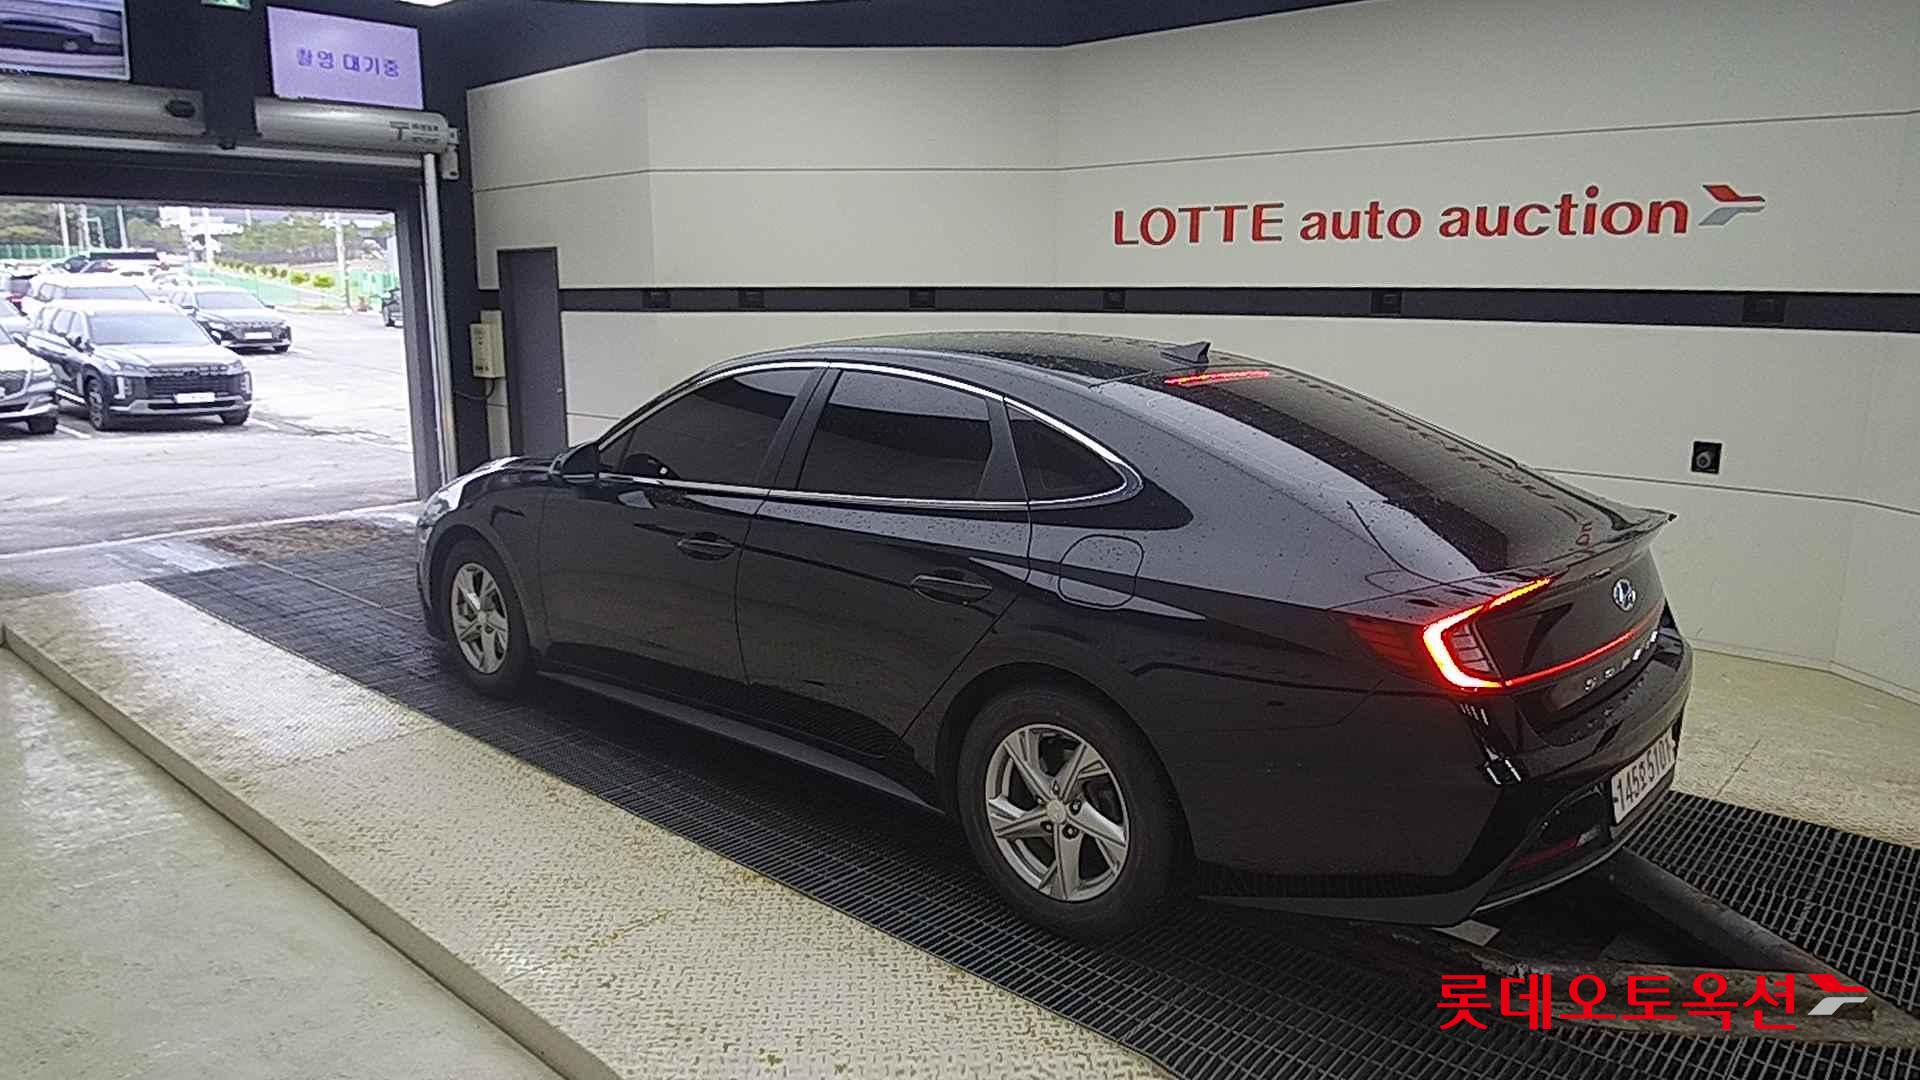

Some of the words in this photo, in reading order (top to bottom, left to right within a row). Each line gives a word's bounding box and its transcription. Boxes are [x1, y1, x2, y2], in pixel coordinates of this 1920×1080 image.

[297, 48, 334, 70] 촬영
[343, 53, 399, 78] 대기중
[1114, 203, 1283, 245] LOTTE
[1299, 200, 1422, 241] auto
[1438, 185, 1690, 238] auction
